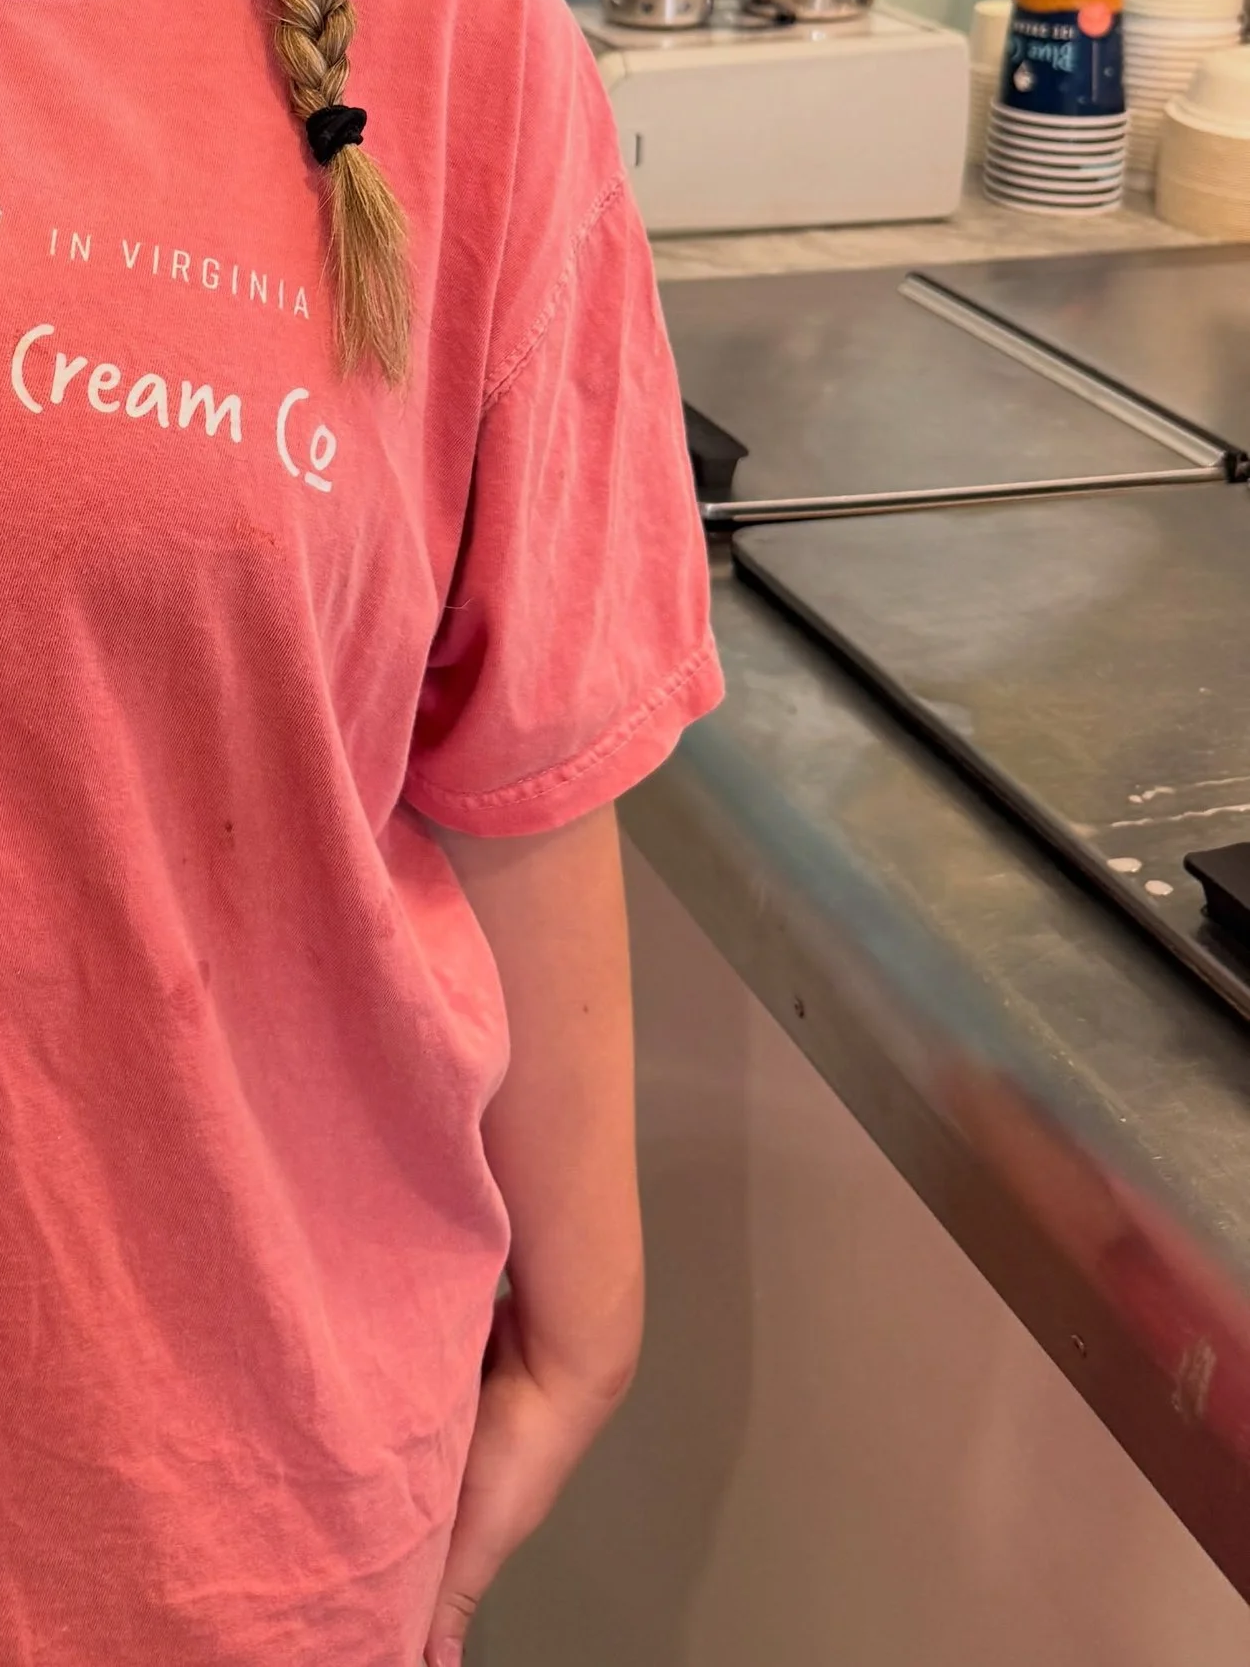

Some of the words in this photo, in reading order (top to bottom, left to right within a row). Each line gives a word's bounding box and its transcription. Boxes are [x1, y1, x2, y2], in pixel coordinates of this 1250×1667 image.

[50, 228, 92, 262] IN
[122, 239, 310, 320] VIRGINIA
[11, 323, 243, 443] Cream
[276, 387, 337, 493] Co
